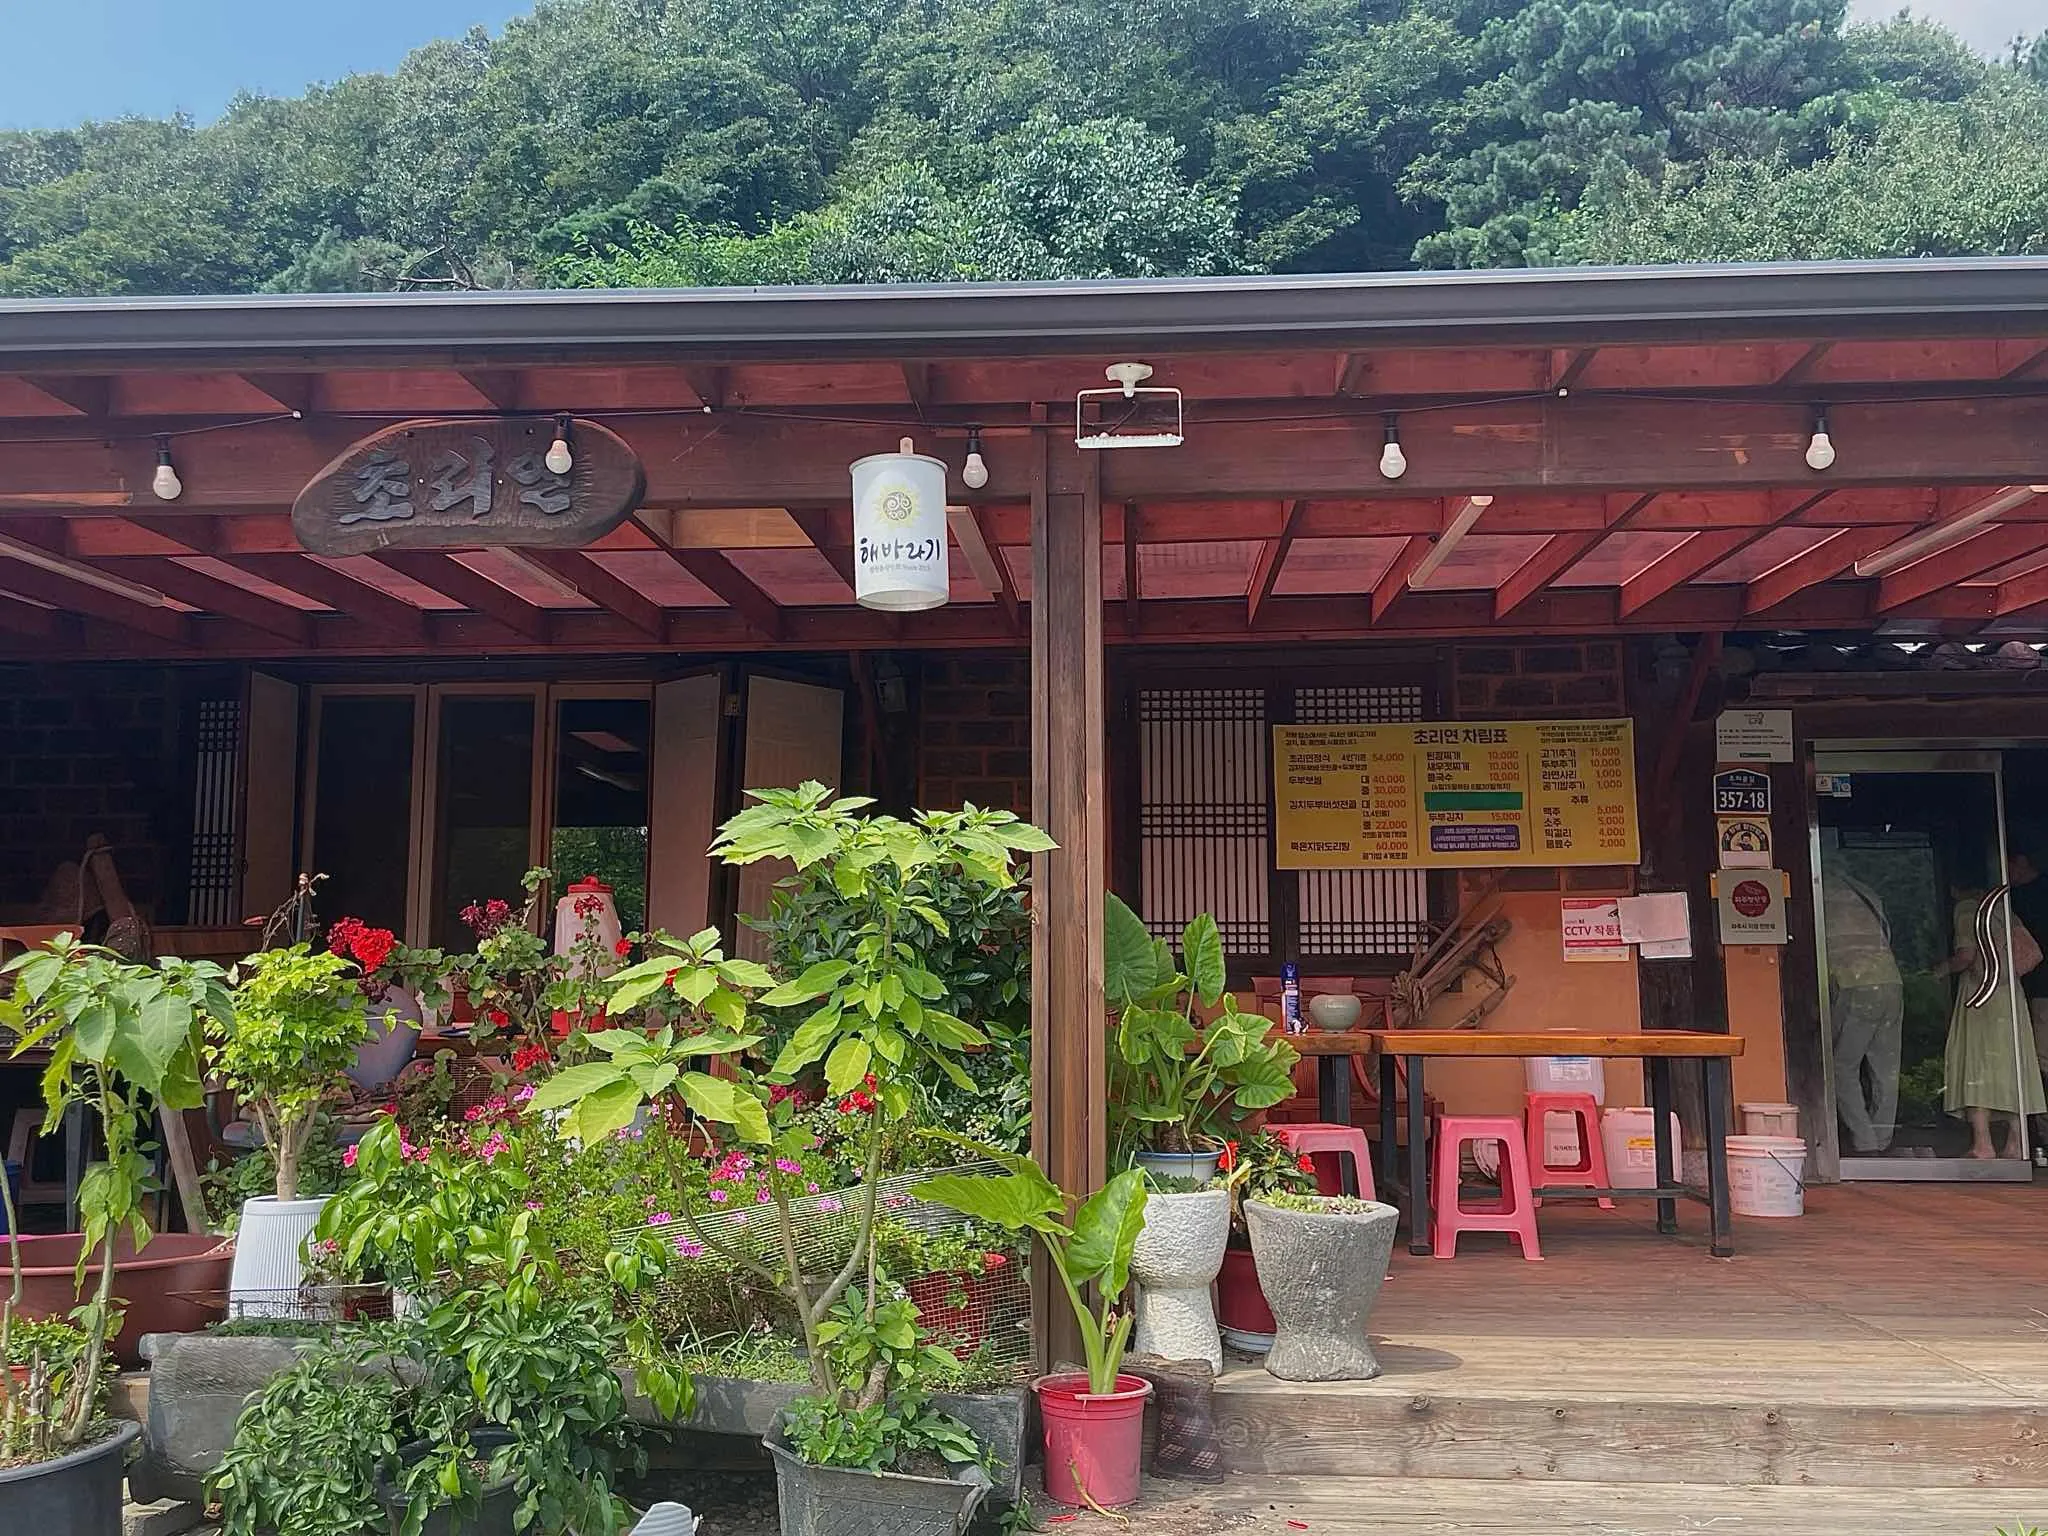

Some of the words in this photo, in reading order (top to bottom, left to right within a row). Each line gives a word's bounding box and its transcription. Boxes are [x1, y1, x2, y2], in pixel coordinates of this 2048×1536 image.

[860, 538, 940, 564] 해바라기
[1414, 729, 1459, 745] 초리연
[1462, 729, 1508, 745] 차림표
[1543, 771, 1576, 779] 라면사리
[1720, 792, 1765, 808] 357-18
[1544, 818, 1561, 827] 소주
[1545, 829, 1571, 837] 막걸리
[1565, 926, 1591, 936] CCTV
